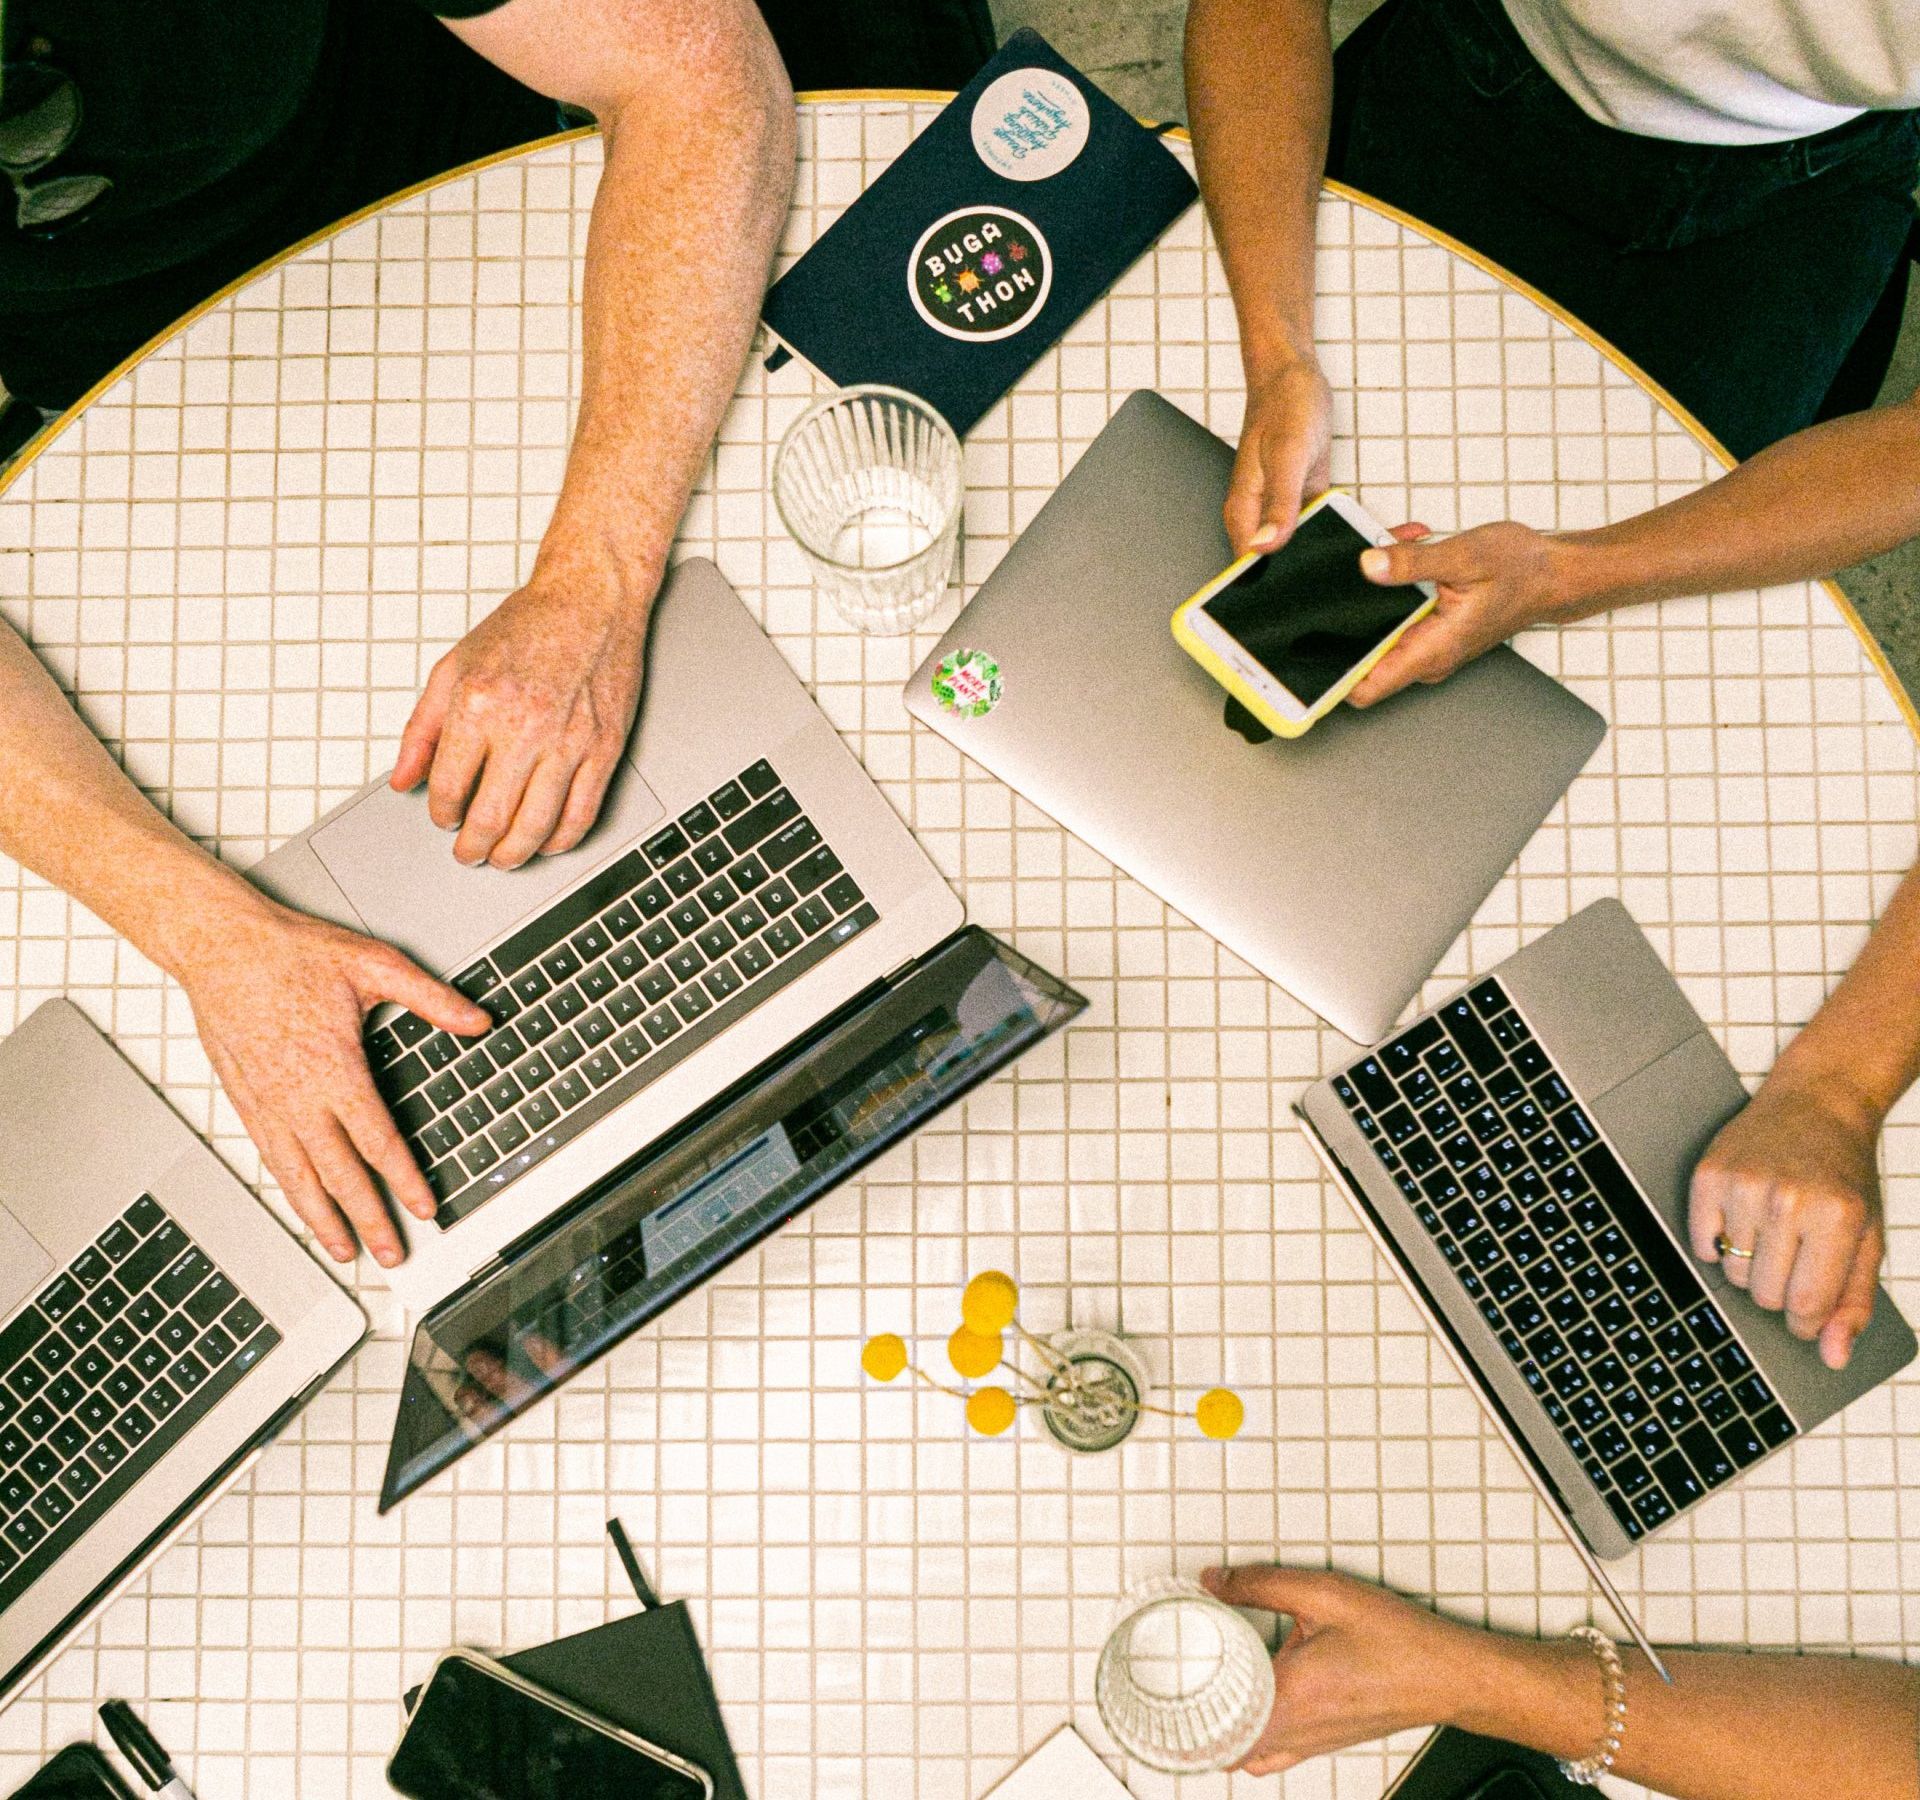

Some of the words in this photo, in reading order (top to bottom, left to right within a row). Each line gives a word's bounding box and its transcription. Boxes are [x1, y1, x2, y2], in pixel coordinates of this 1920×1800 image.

[925, 222, 1002, 277] BUGA
[957, 268, 1035, 322] THON
[771, 793, 785, 805] shift
[684, 808, 702, 823] option
[645, 829, 673, 851] command
[780, 831, 793, 842] lock
[707, 851, 716, 861] Z
[816, 850, 827, 859] tab
[677, 873, 687, 882] X
[743, 868, 751, 878] A
[647, 894, 656, 904] C
[713, 890, 722, 900] S
[770, 892, 781, 902] Q
[805, 907, 812, 915] 1
[617, 916, 627, 926] V
[683, 911, 692, 922] D
[741, 914, 752, 925] W
[774, 927, 783, 937] 2
[586, 937, 596, 947] B
[654, 934, 662, 943] F
[711, 935, 720, 945] E
[743, 949, 753, 959] 3
[555, 959, 566, 969] N
[622, 955, 632, 965] G
[681, 957, 691, 967] R
[713, 971, 721, 980] 4
[525, 980, 536, 991] M
[591, 977, 602, 987] H
[652, 980, 660, 989] T
[683, 992, 692, 1002] 5
[562, 999, 568, 1008] J
[621, 1002, 630, 1011] Y
[653, 1014, 662, 1024] 6
[531, 1020, 541, 1030] K
[589, 1023, 600, 1032] U
[501, 1042, 510, 1050] L
[624, 1037, 632, 1046] 7
[591, 1058, 601, 1068] 8
[561, 1080, 571, 1089] 9
[500, 1088, 508, 1097] P
[1504, 1162, 1512, 1170] L
[1523, 1193, 1532, 1202] K
[1561, 1188, 1573, 1199] M
[1584, 1220, 1594, 1230] N
[101, 1226, 120, 1246] control
[158, 1226, 171, 1239] shift
[74, 1254, 91, 1271] option
[182, 1252, 196, 1265] caps
[1518, 1253, 1528, 1262] U
[172, 1264, 185, 1275] lock
[210, 1278, 221, 1288] tab
[40, 1279, 66, 1305] command
[1626, 1285, 1635, 1293] V
[102, 1296, 112, 1306] Z
[140, 1308, 149, 1317] A
[1560, 1318, 1570, 1326] T
[1647, 1316, 1657, 1325] C
[75, 1322, 86, 1332] X
[170, 1328, 181, 1337] Q
[113, 1335, 123, 1344] S
[206, 1338, 215, 1346] 1
[48, 1349, 58, 1358] C
[1628, 1353, 1638, 1362] D
[1668, 1349, 1678, 1357] X
[144, 1354, 156, 1365] W
[86, 1361, 97, 1371] D
[178, 1363, 188, 1372] 2
[22, 1375, 32, 1385] V
[1689, 1381, 1700, 1389] Z
[117, 1381, 127, 1391] E
[1603, 1381, 1613, 1390] E
[1649, 1384, 1659, 1394] S
[62, 1388, 69, 1397] F
[151, 1390, 161, 1399] 3
[91, 1407, 101, 1417] R
[32, 1414, 42, 1424] G
[125, 1417, 132, 1425] 4
[1623, 1412, 1634, 1423] W
[1671, 1416, 1680, 1424] A
[65, 1435, 74, 1443] T
[5, 1440, 15, 1451] H
[97, 1443, 107, 1452] 5
[1645, 1444, 1655, 1454] Q
[38, 1462, 46, 1470] Y
[70, 1469, 80, 1478] 6
[9, 1487, 19, 1497] U
[45, 1496, 53, 1505] 7
[16, 1522, 25, 1531] 8
